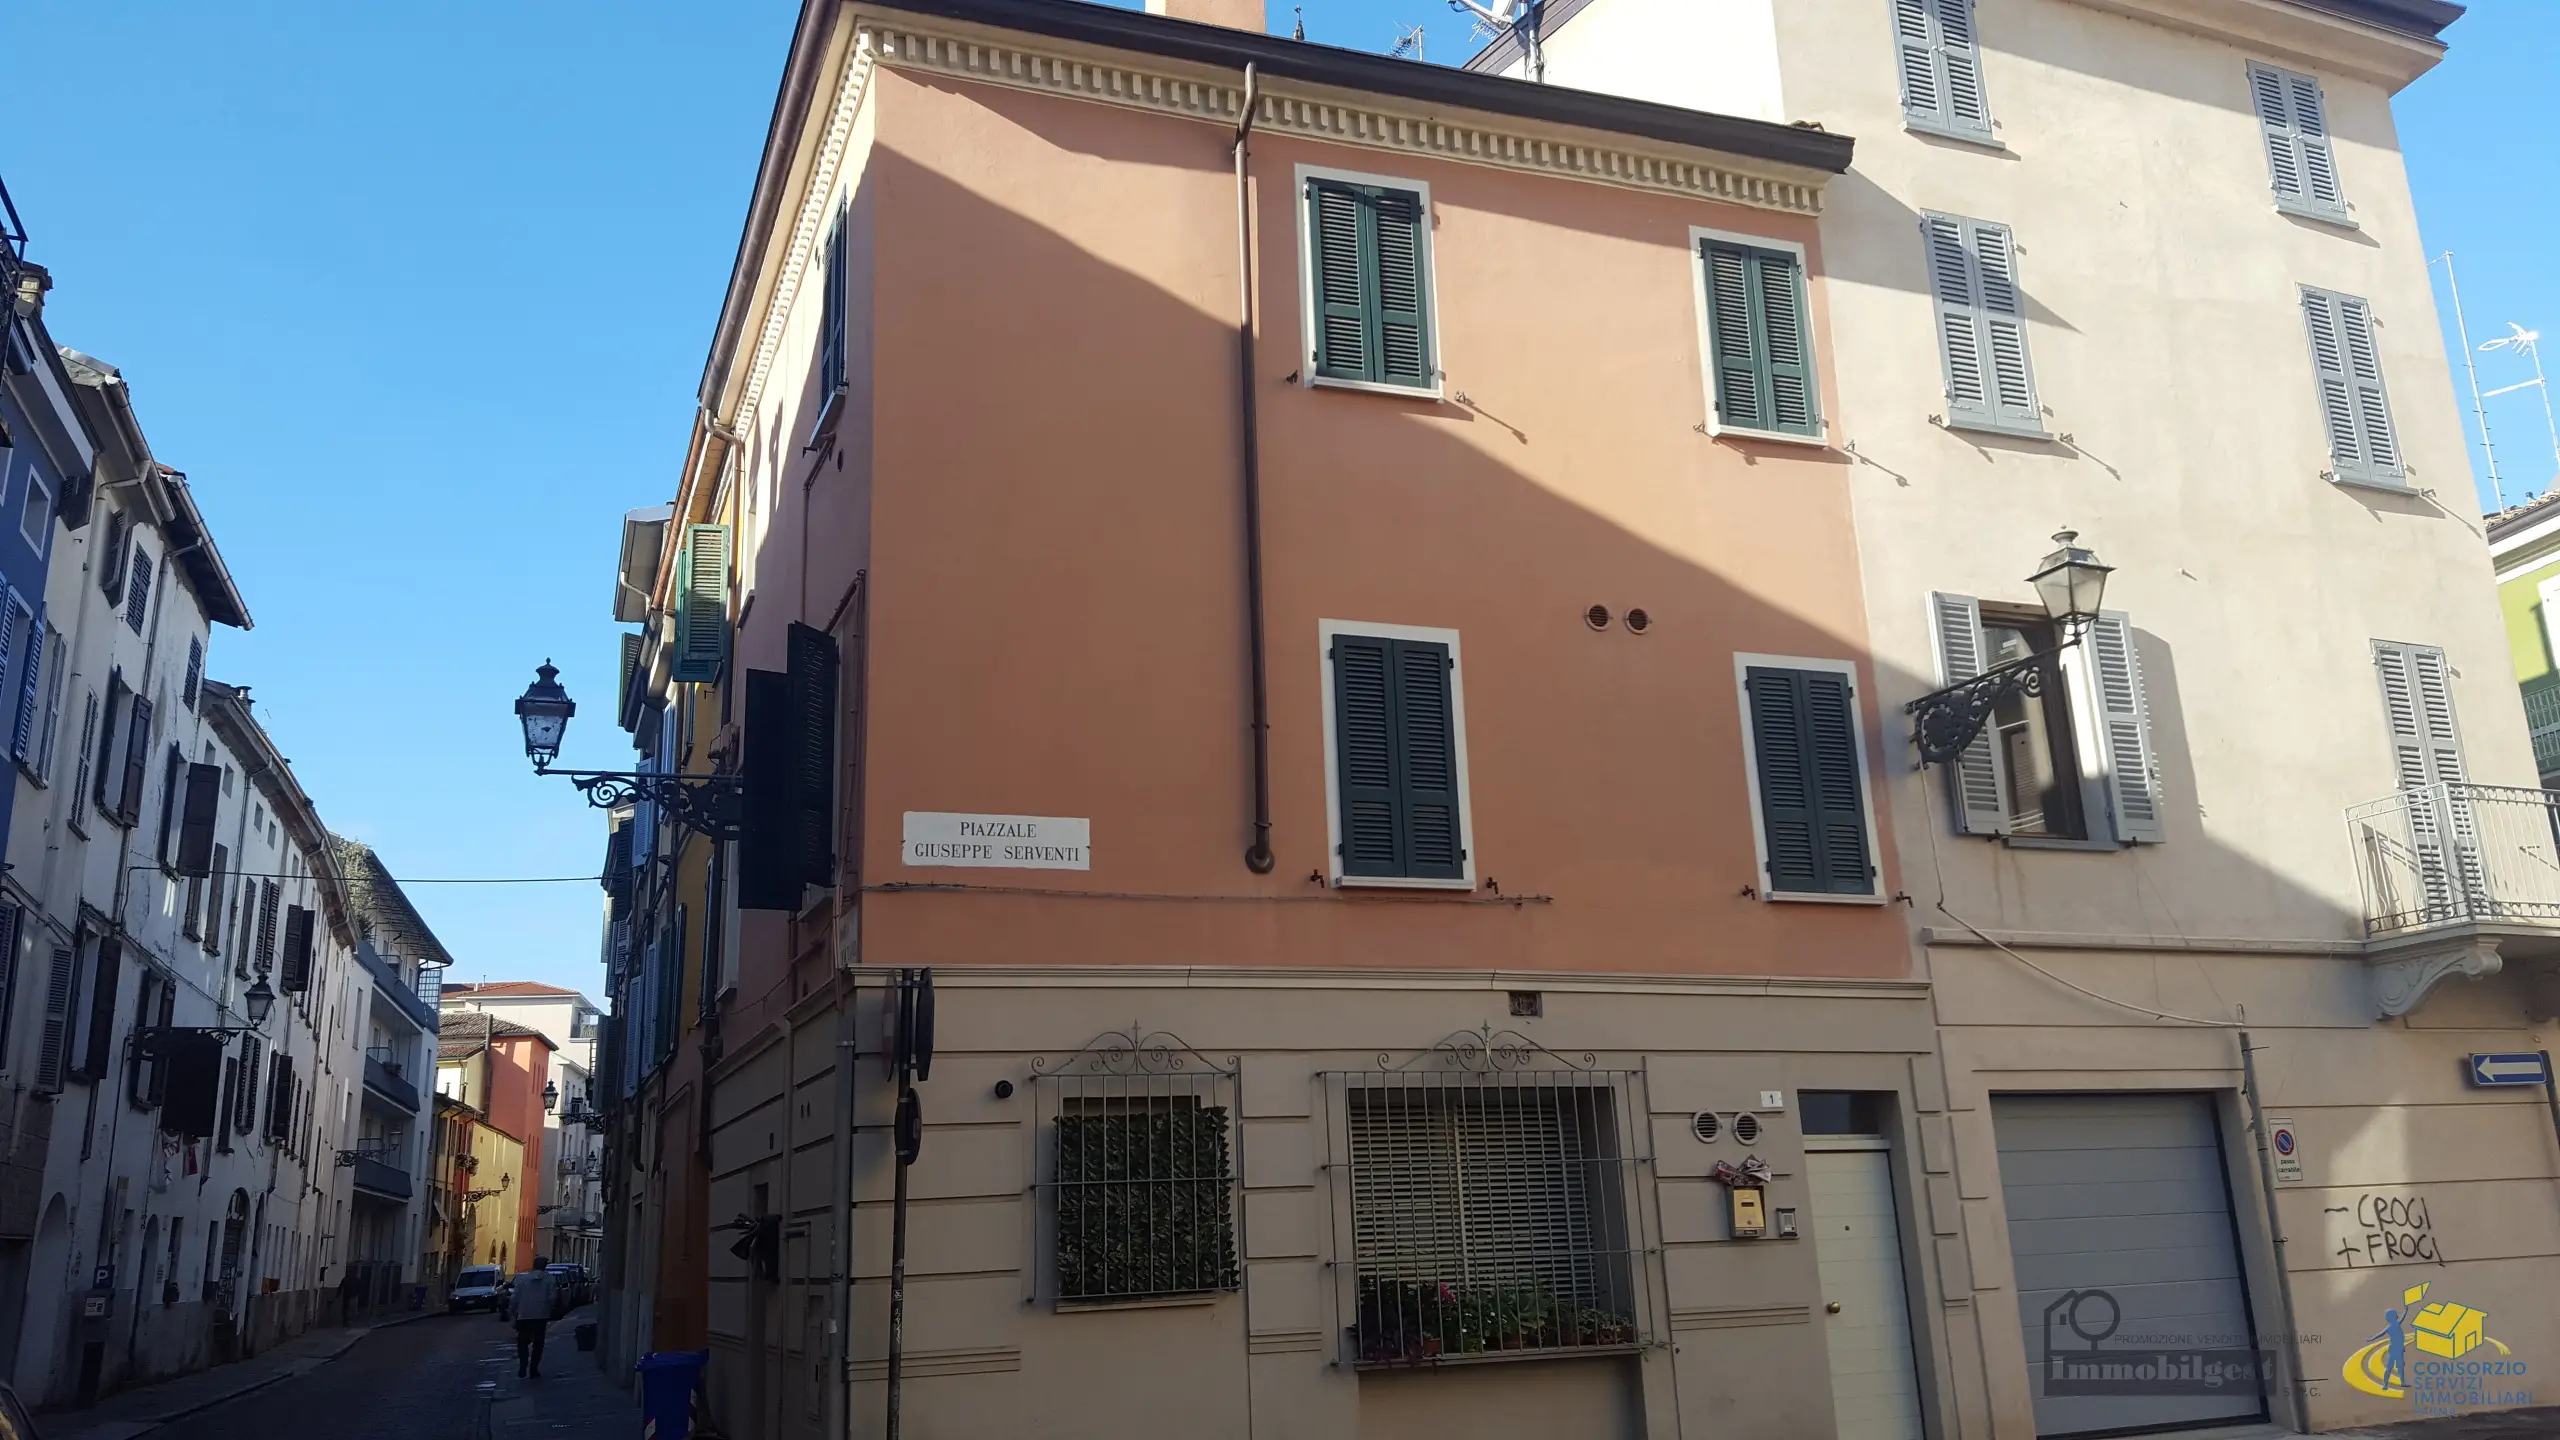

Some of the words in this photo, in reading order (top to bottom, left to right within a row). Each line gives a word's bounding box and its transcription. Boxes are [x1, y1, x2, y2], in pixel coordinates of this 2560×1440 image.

[960, 822, 1037, 838] PIAZZALE
[915, 843, 993, 860] GIUSEPPE
[1003, 845, 1080, 862] SERVENTI
[96, 1269, 109, 1284] P
